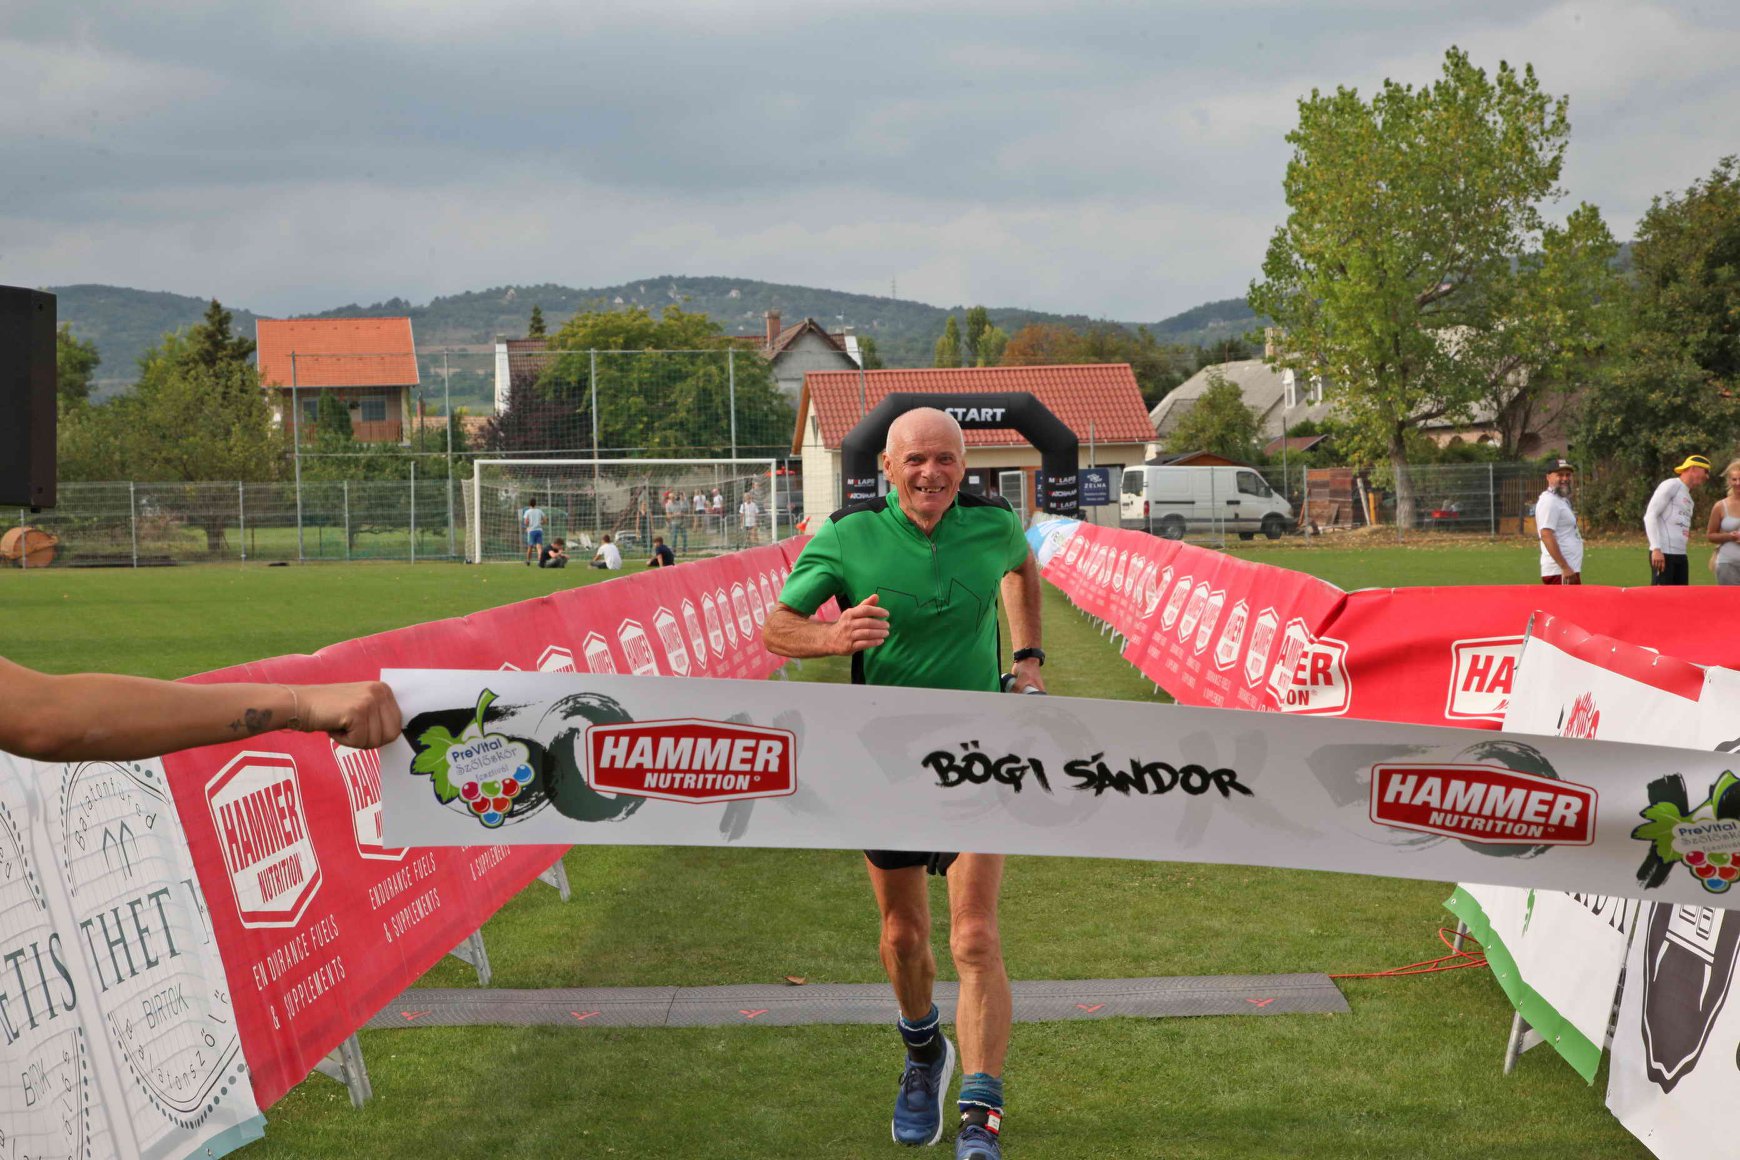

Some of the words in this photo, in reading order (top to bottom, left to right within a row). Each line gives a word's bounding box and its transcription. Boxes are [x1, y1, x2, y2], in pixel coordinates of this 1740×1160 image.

[452, 738, 503, 762] PreVital
[599, 736, 784, 772] HAMMER
[921, 740, 1055, 796] BÖGI
[1063, 751, 1255, 799] SÁNDOR
[341, 748, 382, 812] HAM
[1383, 773, 1583, 828] HAMMER
[218, 778, 304, 874] HAMMER
[1678, 820, 1738, 837] PreVital
[256, 852, 305, 904] NUTRITION
[368, 866, 413, 911] ENDURANCE
[414, 851, 437, 877] FUELS
[310, 913, 340, 951] FUELS
[383, 921, 393, 943] &
[392, 887, 441, 937] SUPPLEMENTS
[142, 982, 190, 1030] BIRTOK
[270, 1005, 281, 1031] &
[283, 954, 347, 1021] SUPPLEMENTS
